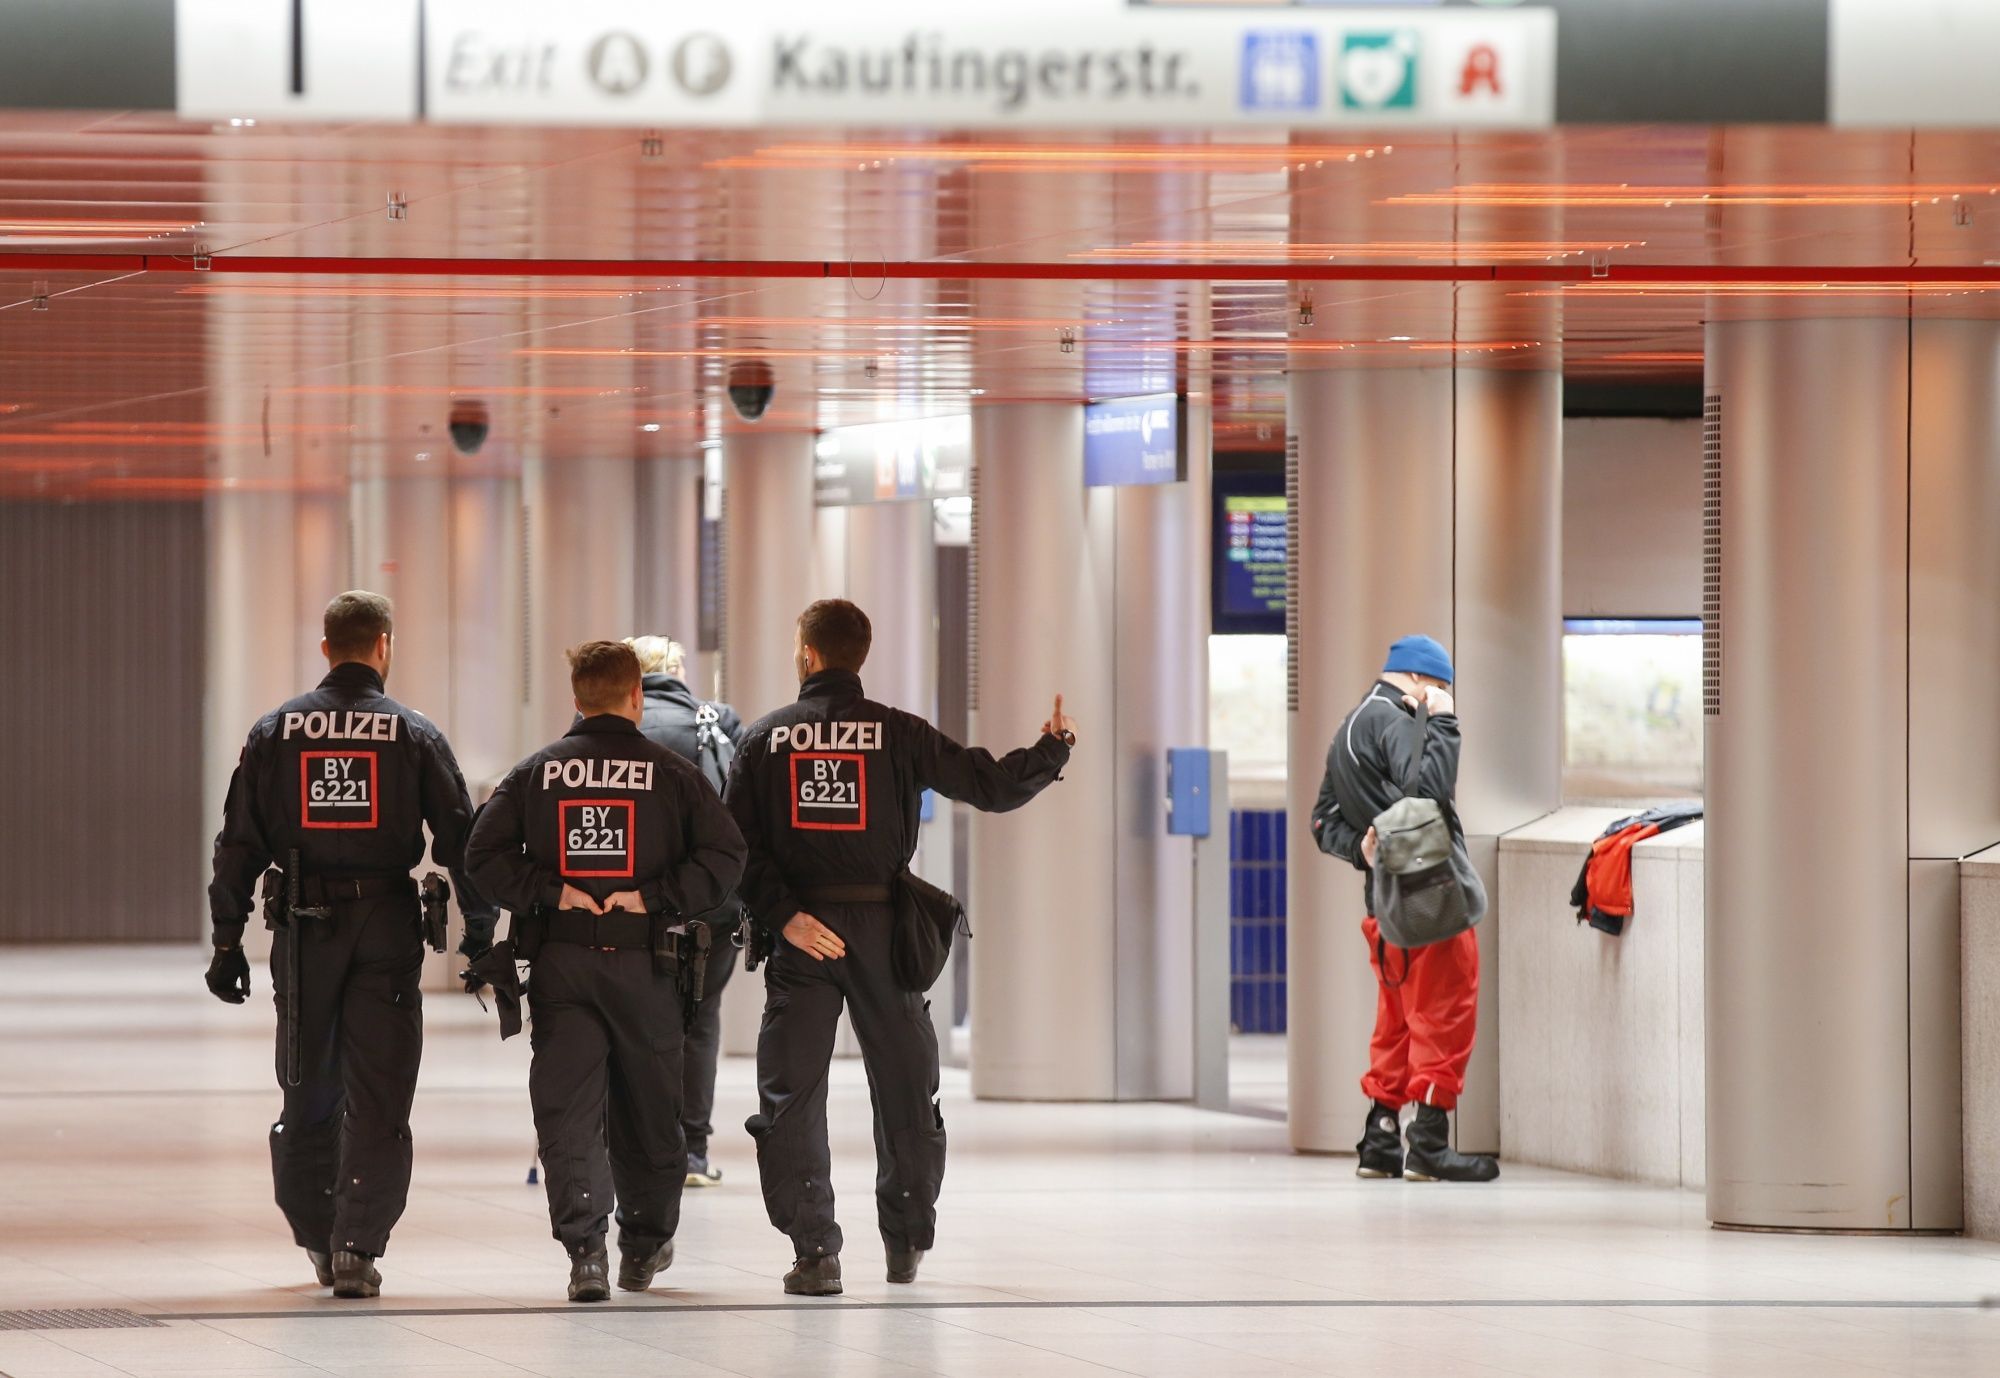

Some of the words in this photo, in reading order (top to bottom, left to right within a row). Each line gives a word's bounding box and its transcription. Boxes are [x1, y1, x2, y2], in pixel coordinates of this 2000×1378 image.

[446, 30, 558, 92] Exit
[772, 33, 1199, 113] Kaufingerstr.
[282, 711, 399, 742] POLIZEI
[770, 721, 883, 754] POLIZEI
[324, 757, 353, 780] BY
[542, 758, 654, 791] POLIZEI
[813, 759, 842, 781] BY
[310, 779, 367, 801] 6221
[800, 780, 856, 802] 6221
[582, 806, 611, 828] BY
[568, 828, 624, 850] 6221
